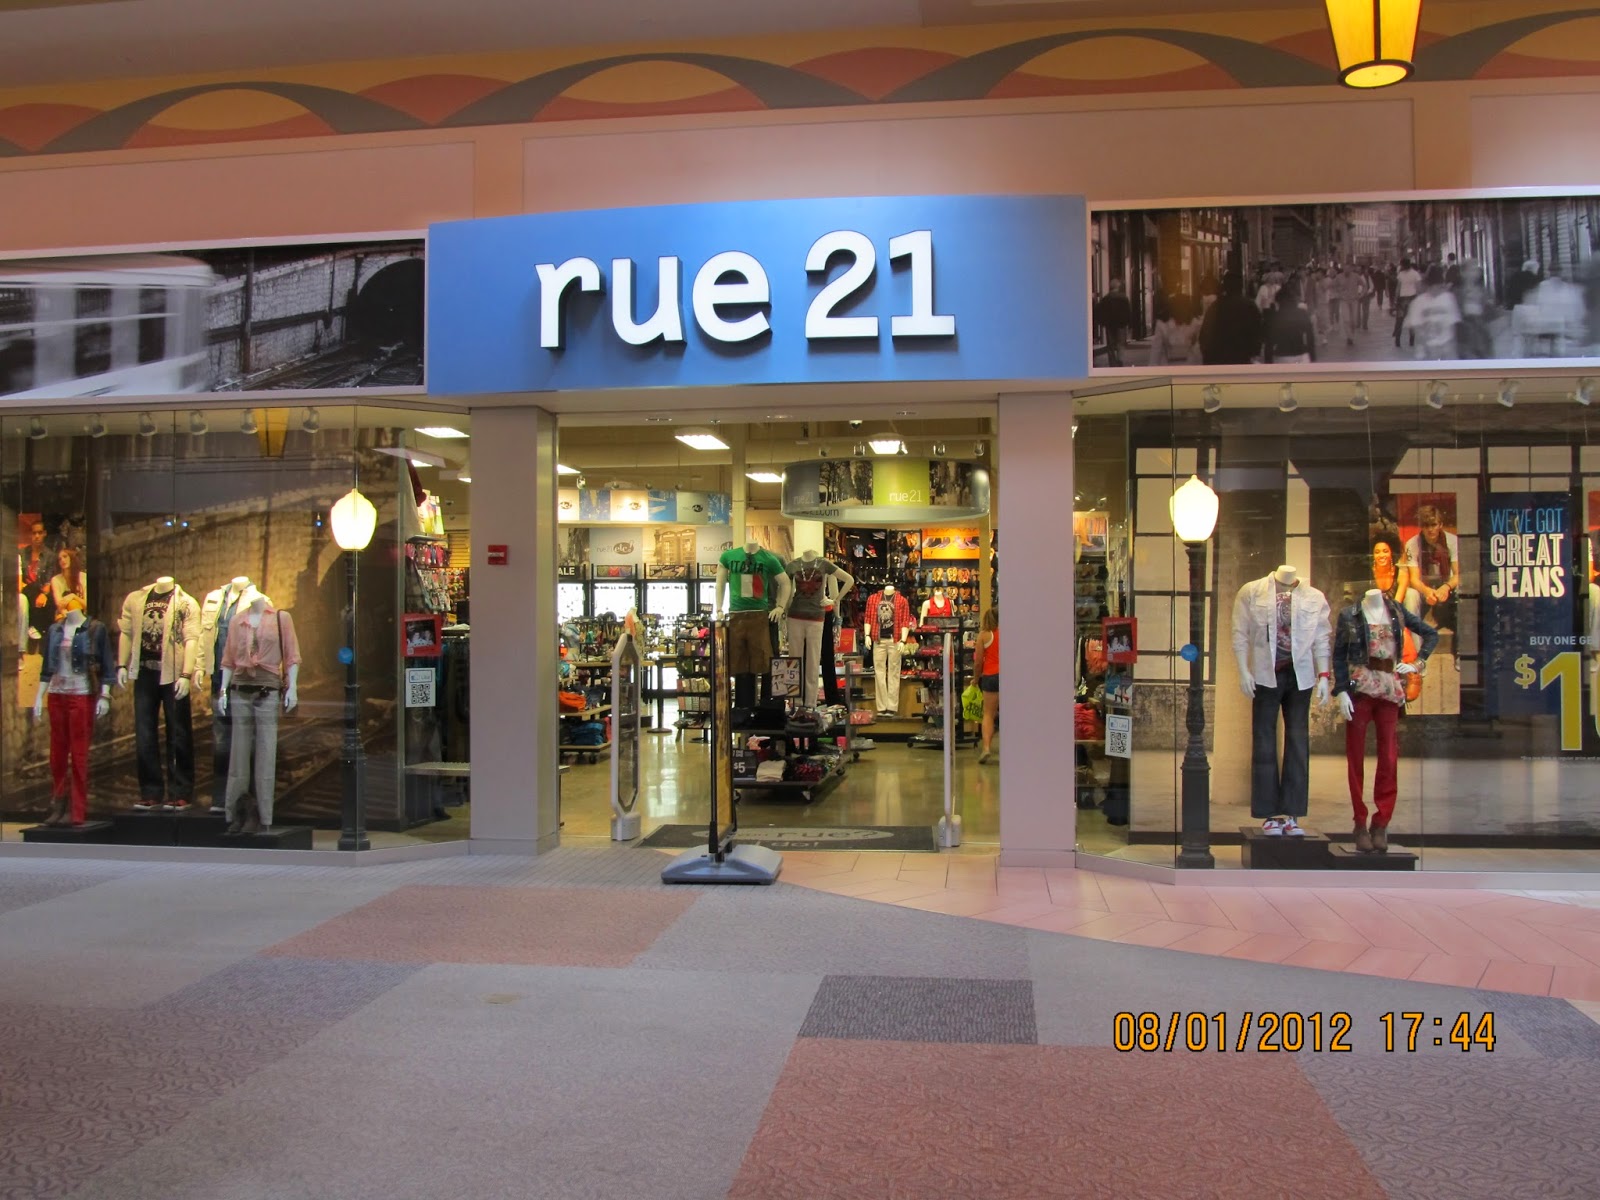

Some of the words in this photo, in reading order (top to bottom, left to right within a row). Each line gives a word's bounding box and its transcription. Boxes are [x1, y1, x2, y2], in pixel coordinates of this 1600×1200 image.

[534, 249, 772, 349] rue
[804, 229, 956, 338] 21
[1490, 508, 1532, 534] WE'VE
[1536, 508, 1564, 533] GOT
[1490, 533, 1565, 566] GREAT
[558, 567, 576, 576] ALE
[1491, 566, 1565, 598] JEANS
[1529, 636, 1552, 646] BUY
[1554, 636, 1577, 646] ONE
[1579, 636, 1595, 646] GE
[1514, 651, 1600, 751] $1
[733, 761, 746, 774] $5
